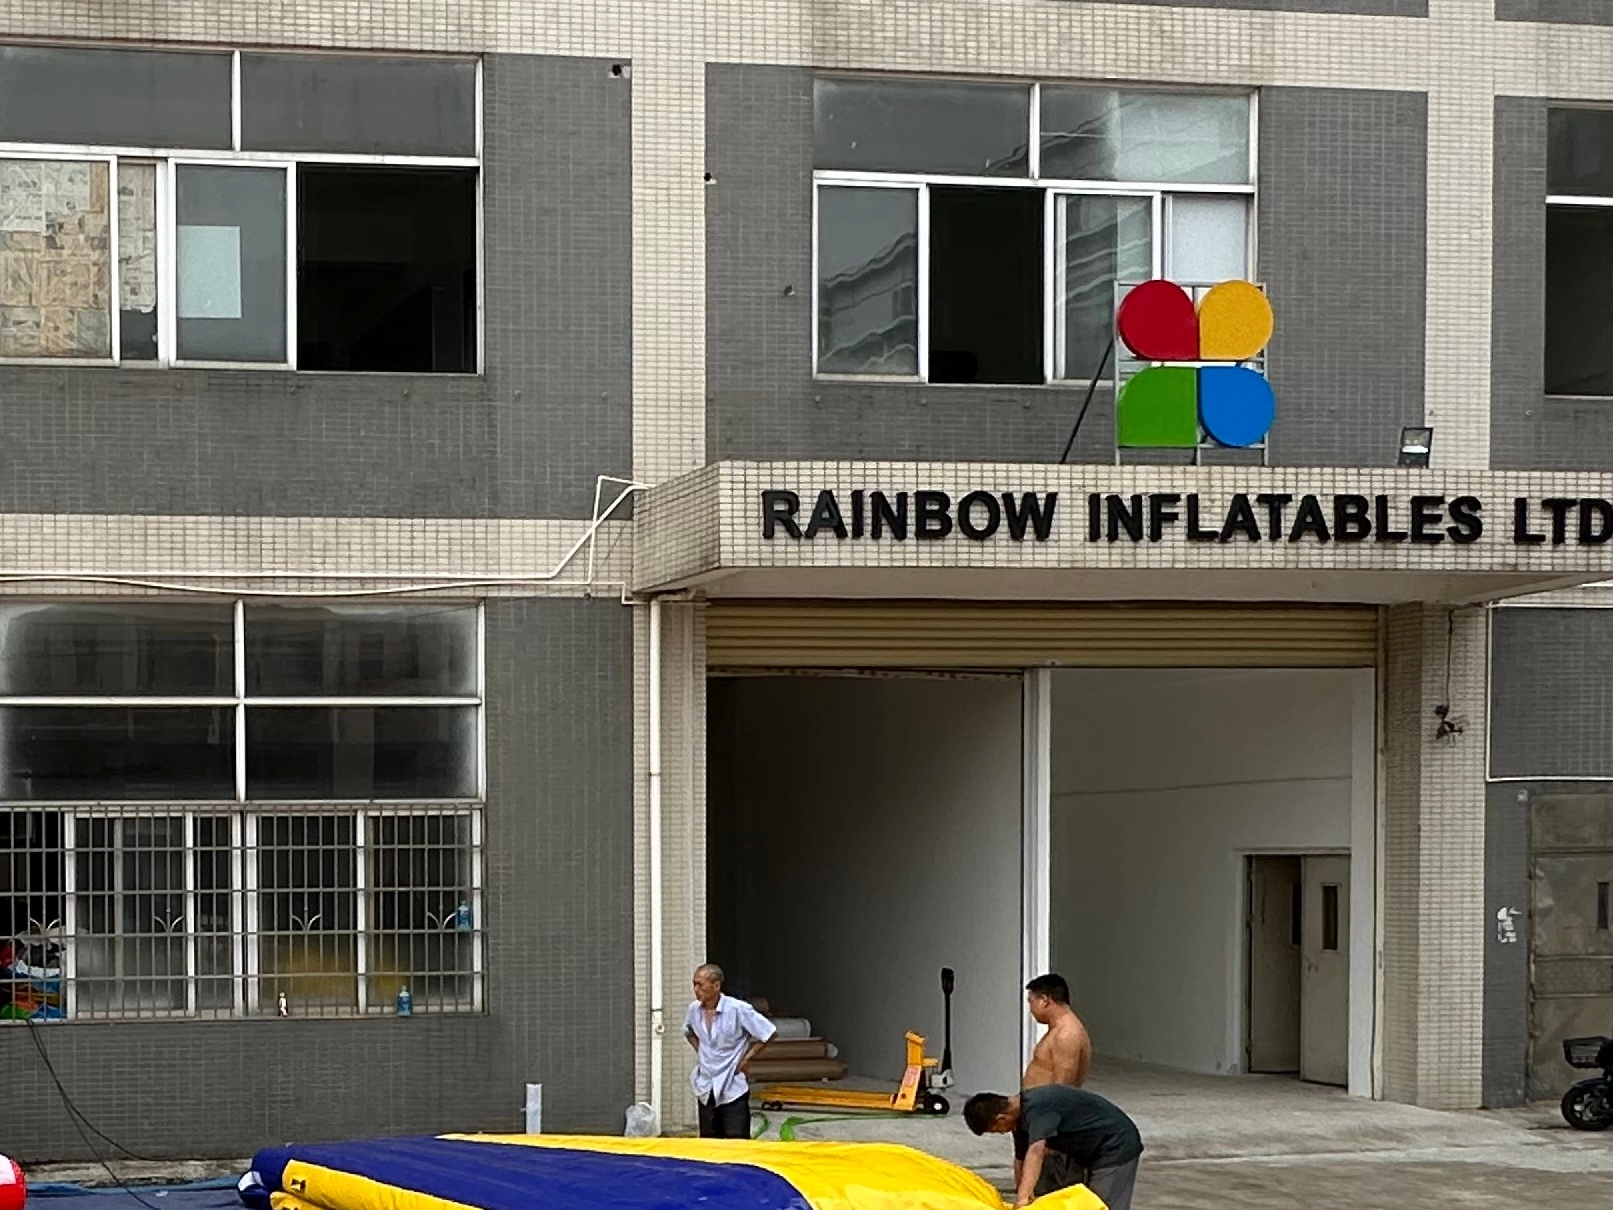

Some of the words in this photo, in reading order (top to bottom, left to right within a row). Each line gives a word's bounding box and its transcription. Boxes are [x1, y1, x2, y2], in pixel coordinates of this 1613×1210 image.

[761, 489, 1058, 542] RAINBOW
[1088, 492, 1483, 544] INFLATABLES
[1514, 498, 1613, 544] LTD
